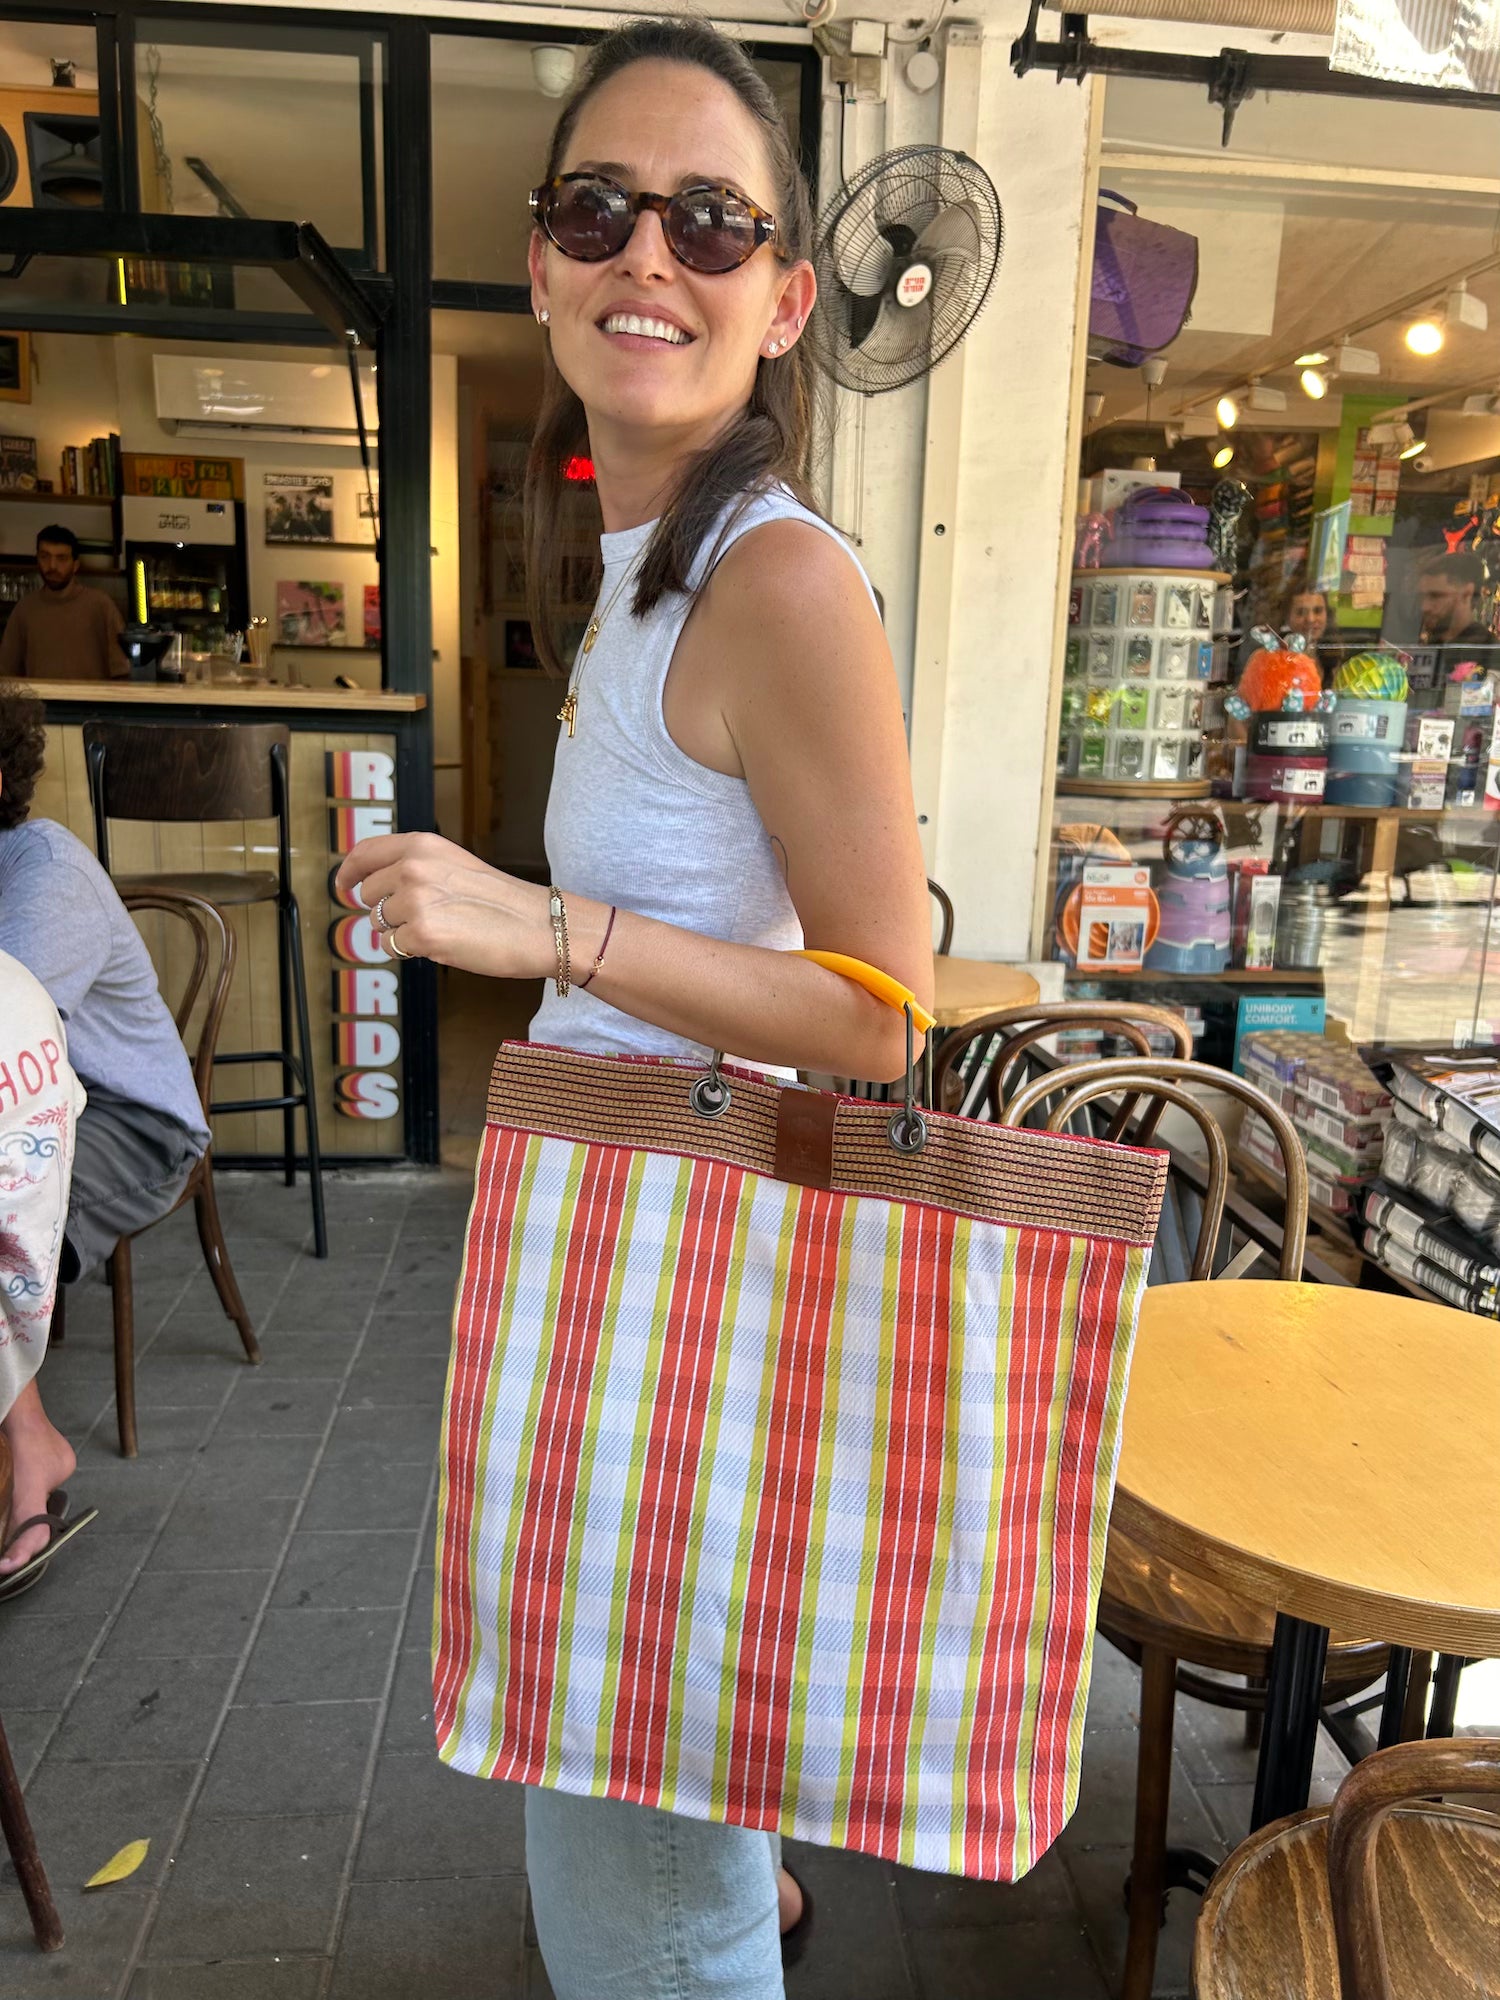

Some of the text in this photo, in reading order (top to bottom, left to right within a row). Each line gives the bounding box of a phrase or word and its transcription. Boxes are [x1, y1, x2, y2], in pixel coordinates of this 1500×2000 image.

[1245, 1004, 1295, 1014] UNIBODY
[1244, 1014, 1298, 1025] COMFORT.
[0, 1039, 60, 1113] HOP
